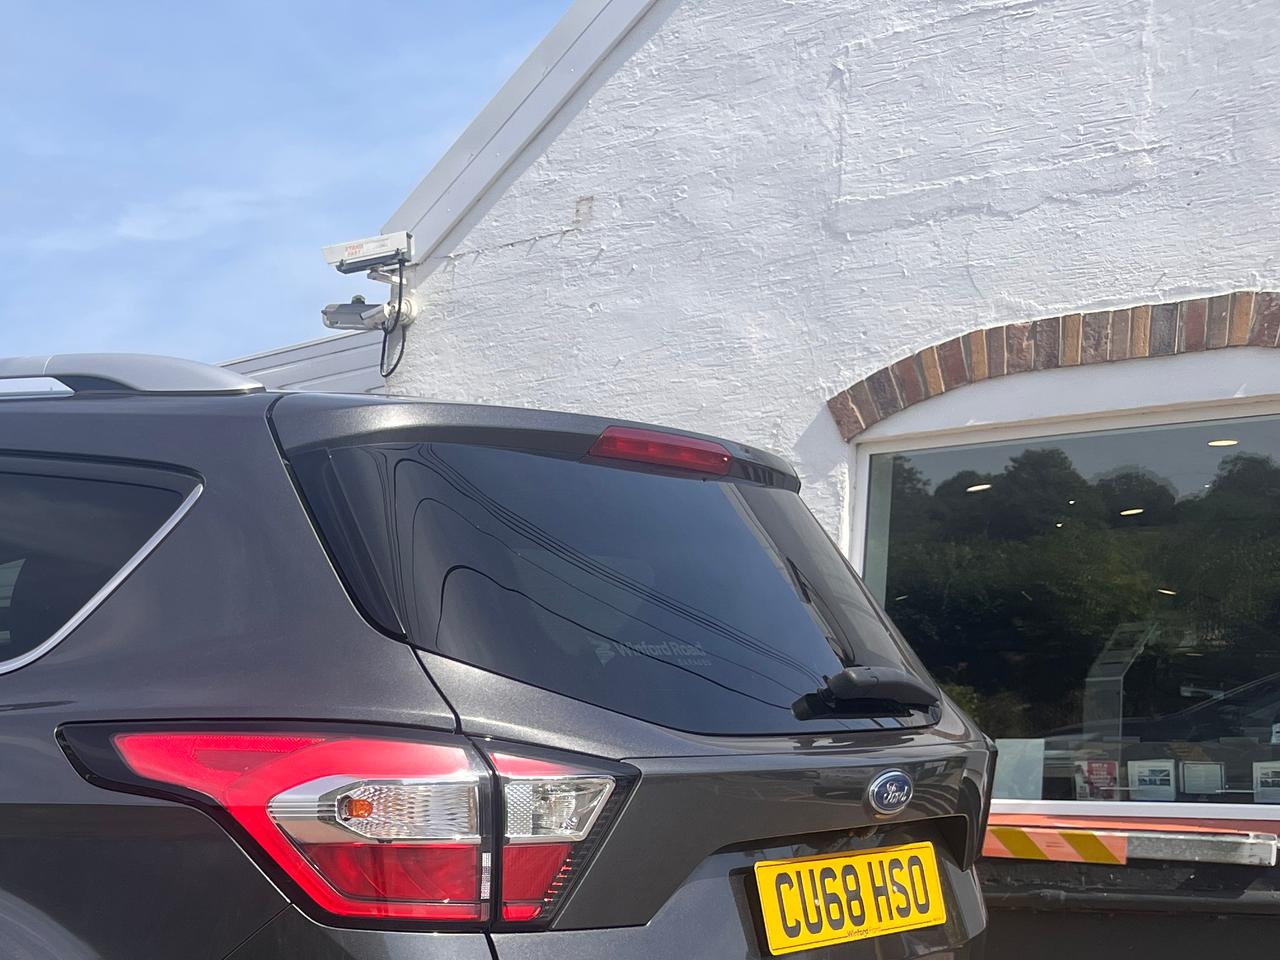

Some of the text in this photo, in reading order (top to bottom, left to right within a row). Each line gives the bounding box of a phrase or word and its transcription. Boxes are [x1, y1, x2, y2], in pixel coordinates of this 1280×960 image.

[883, 781, 908, 804] Ford
[775, 855, 930, 938] CU68 HSO
